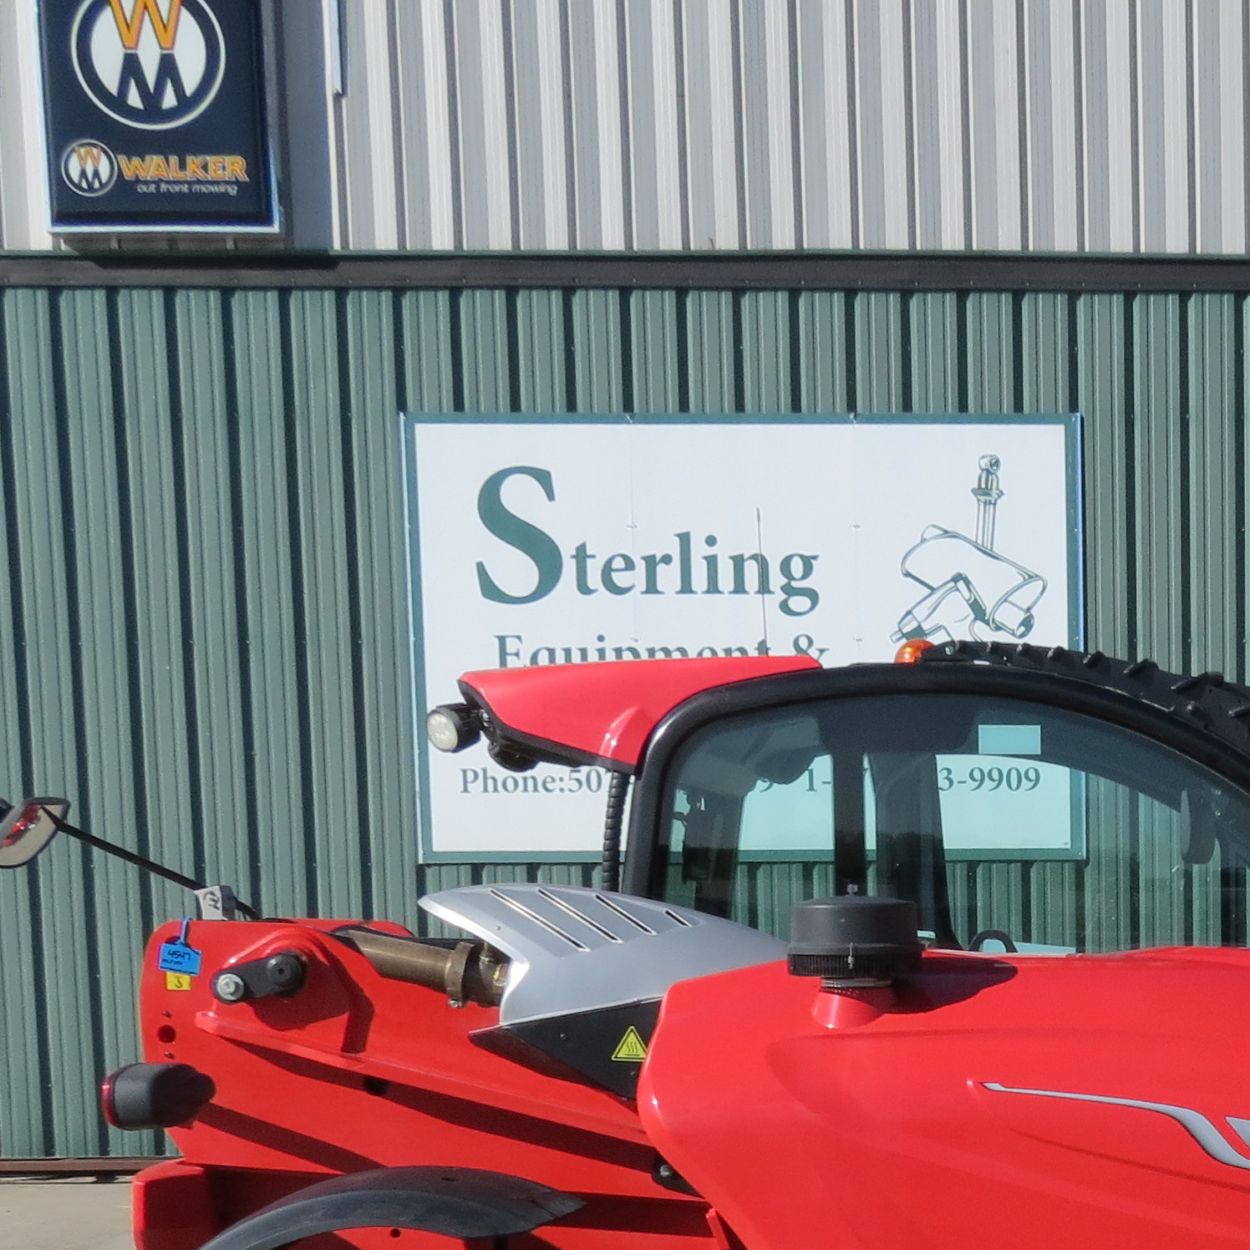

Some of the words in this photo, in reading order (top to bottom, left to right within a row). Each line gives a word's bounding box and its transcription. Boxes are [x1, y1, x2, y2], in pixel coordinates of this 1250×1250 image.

[116, 154, 250, 182] WALKER
[137, 184, 156, 193] out
[160, 183, 189, 193] front
[192, 184, 238, 196] mowing
[475, 465, 820, 617] Sterling
